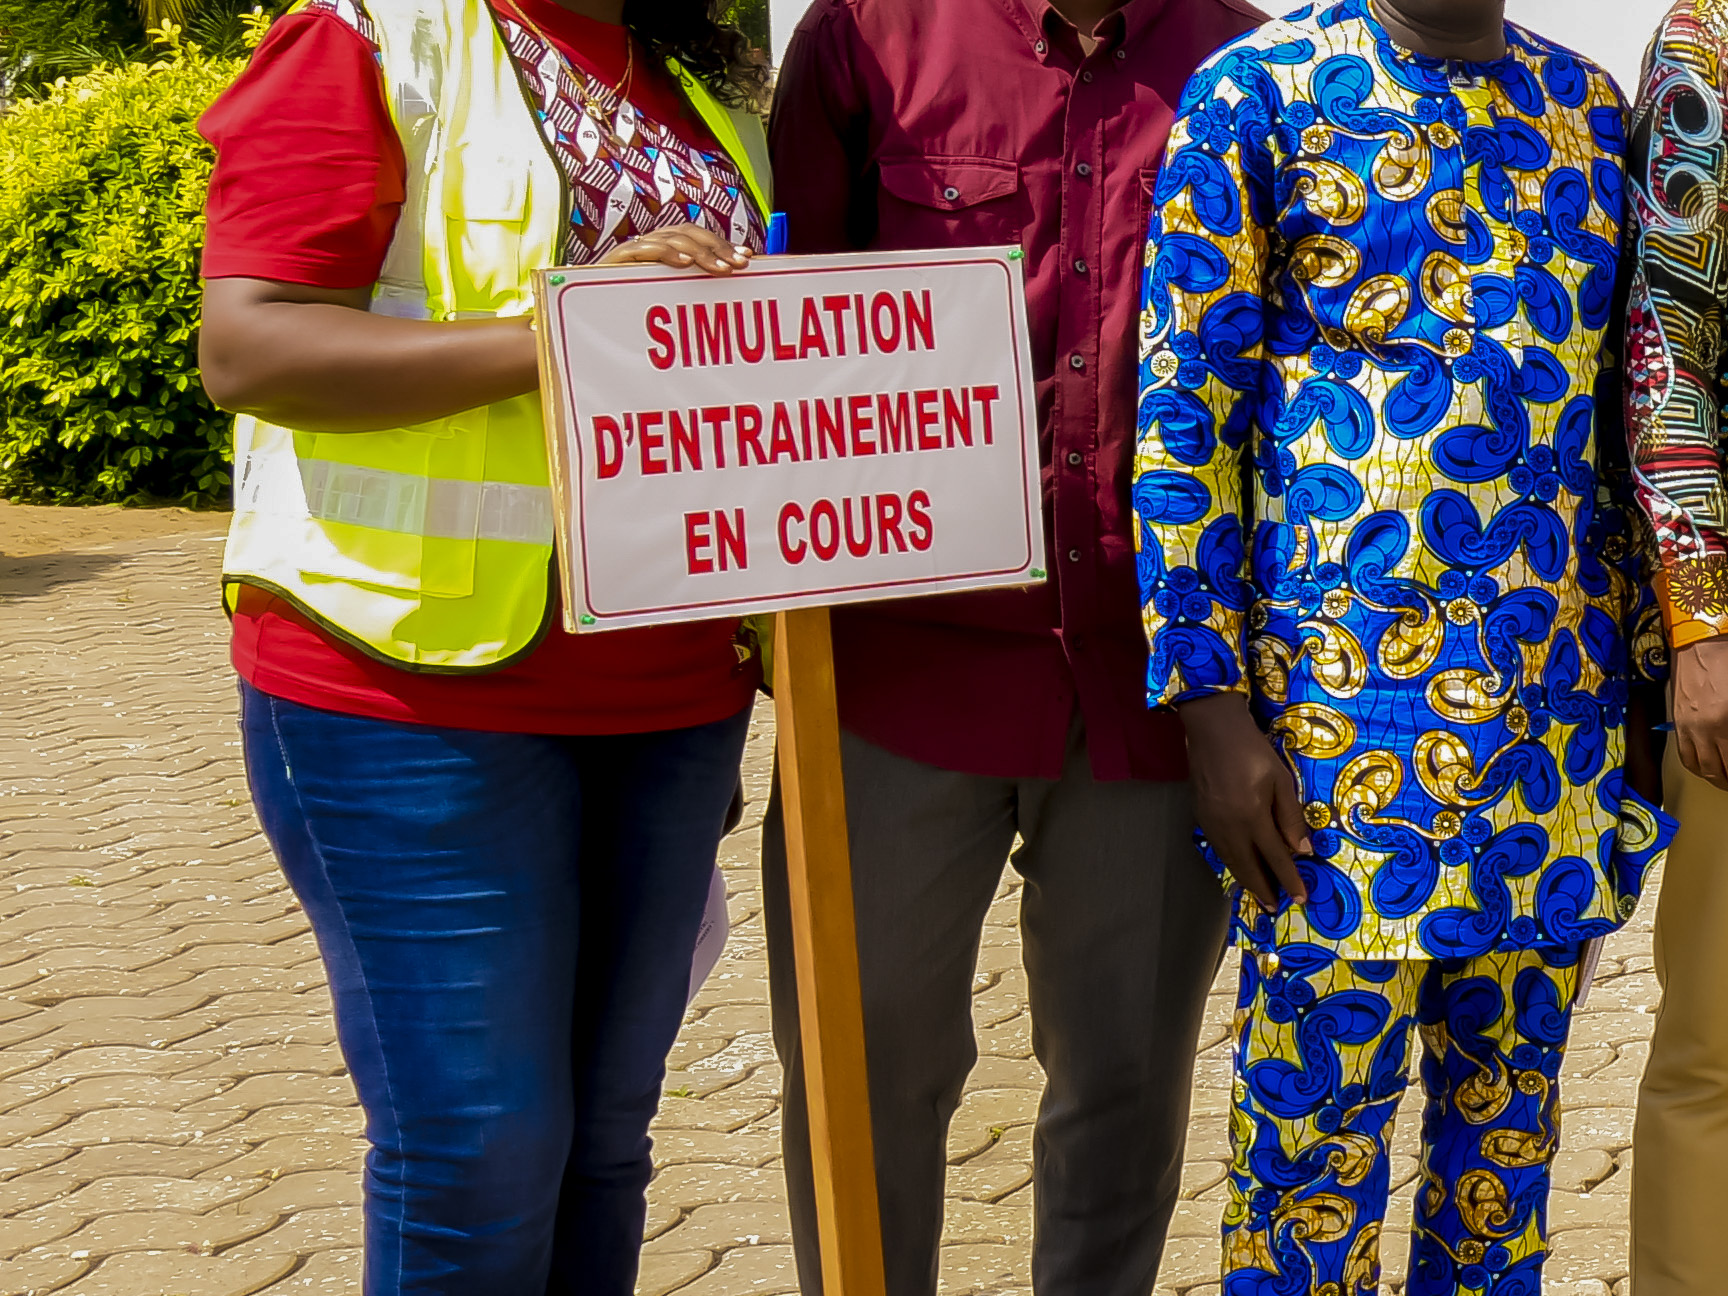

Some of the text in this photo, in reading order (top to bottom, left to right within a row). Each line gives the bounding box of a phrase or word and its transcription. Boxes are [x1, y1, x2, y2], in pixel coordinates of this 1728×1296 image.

[647, 290, 935, 370] SIMULATION
[593, 385, 1000, 480] D'ENTRAINEMENT
[686, 490, 934, 575] EN COURS
